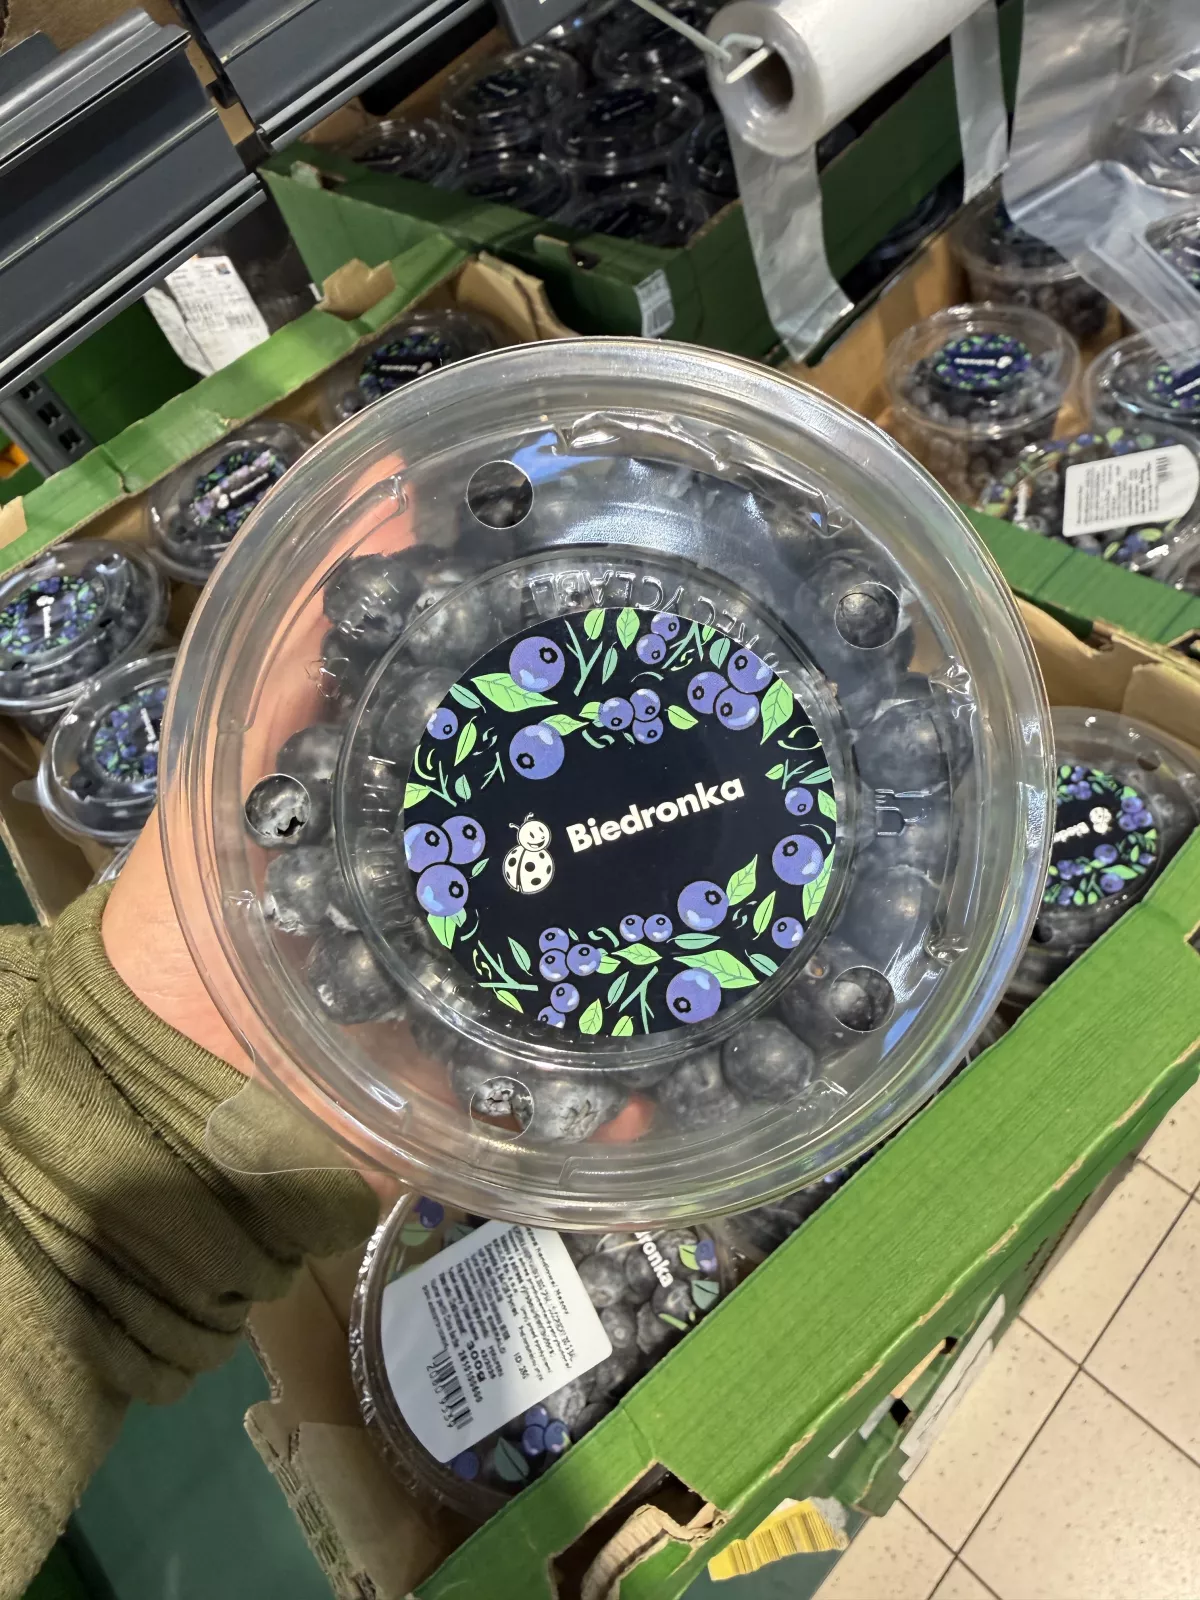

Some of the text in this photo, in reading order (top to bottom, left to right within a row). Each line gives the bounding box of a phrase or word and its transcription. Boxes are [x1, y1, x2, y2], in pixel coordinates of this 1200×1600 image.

[566, 778, 745, 853] Biedronka
[634, 1231, 674, 1288] ronka
[466, 1340, 487, 1382] 300g
